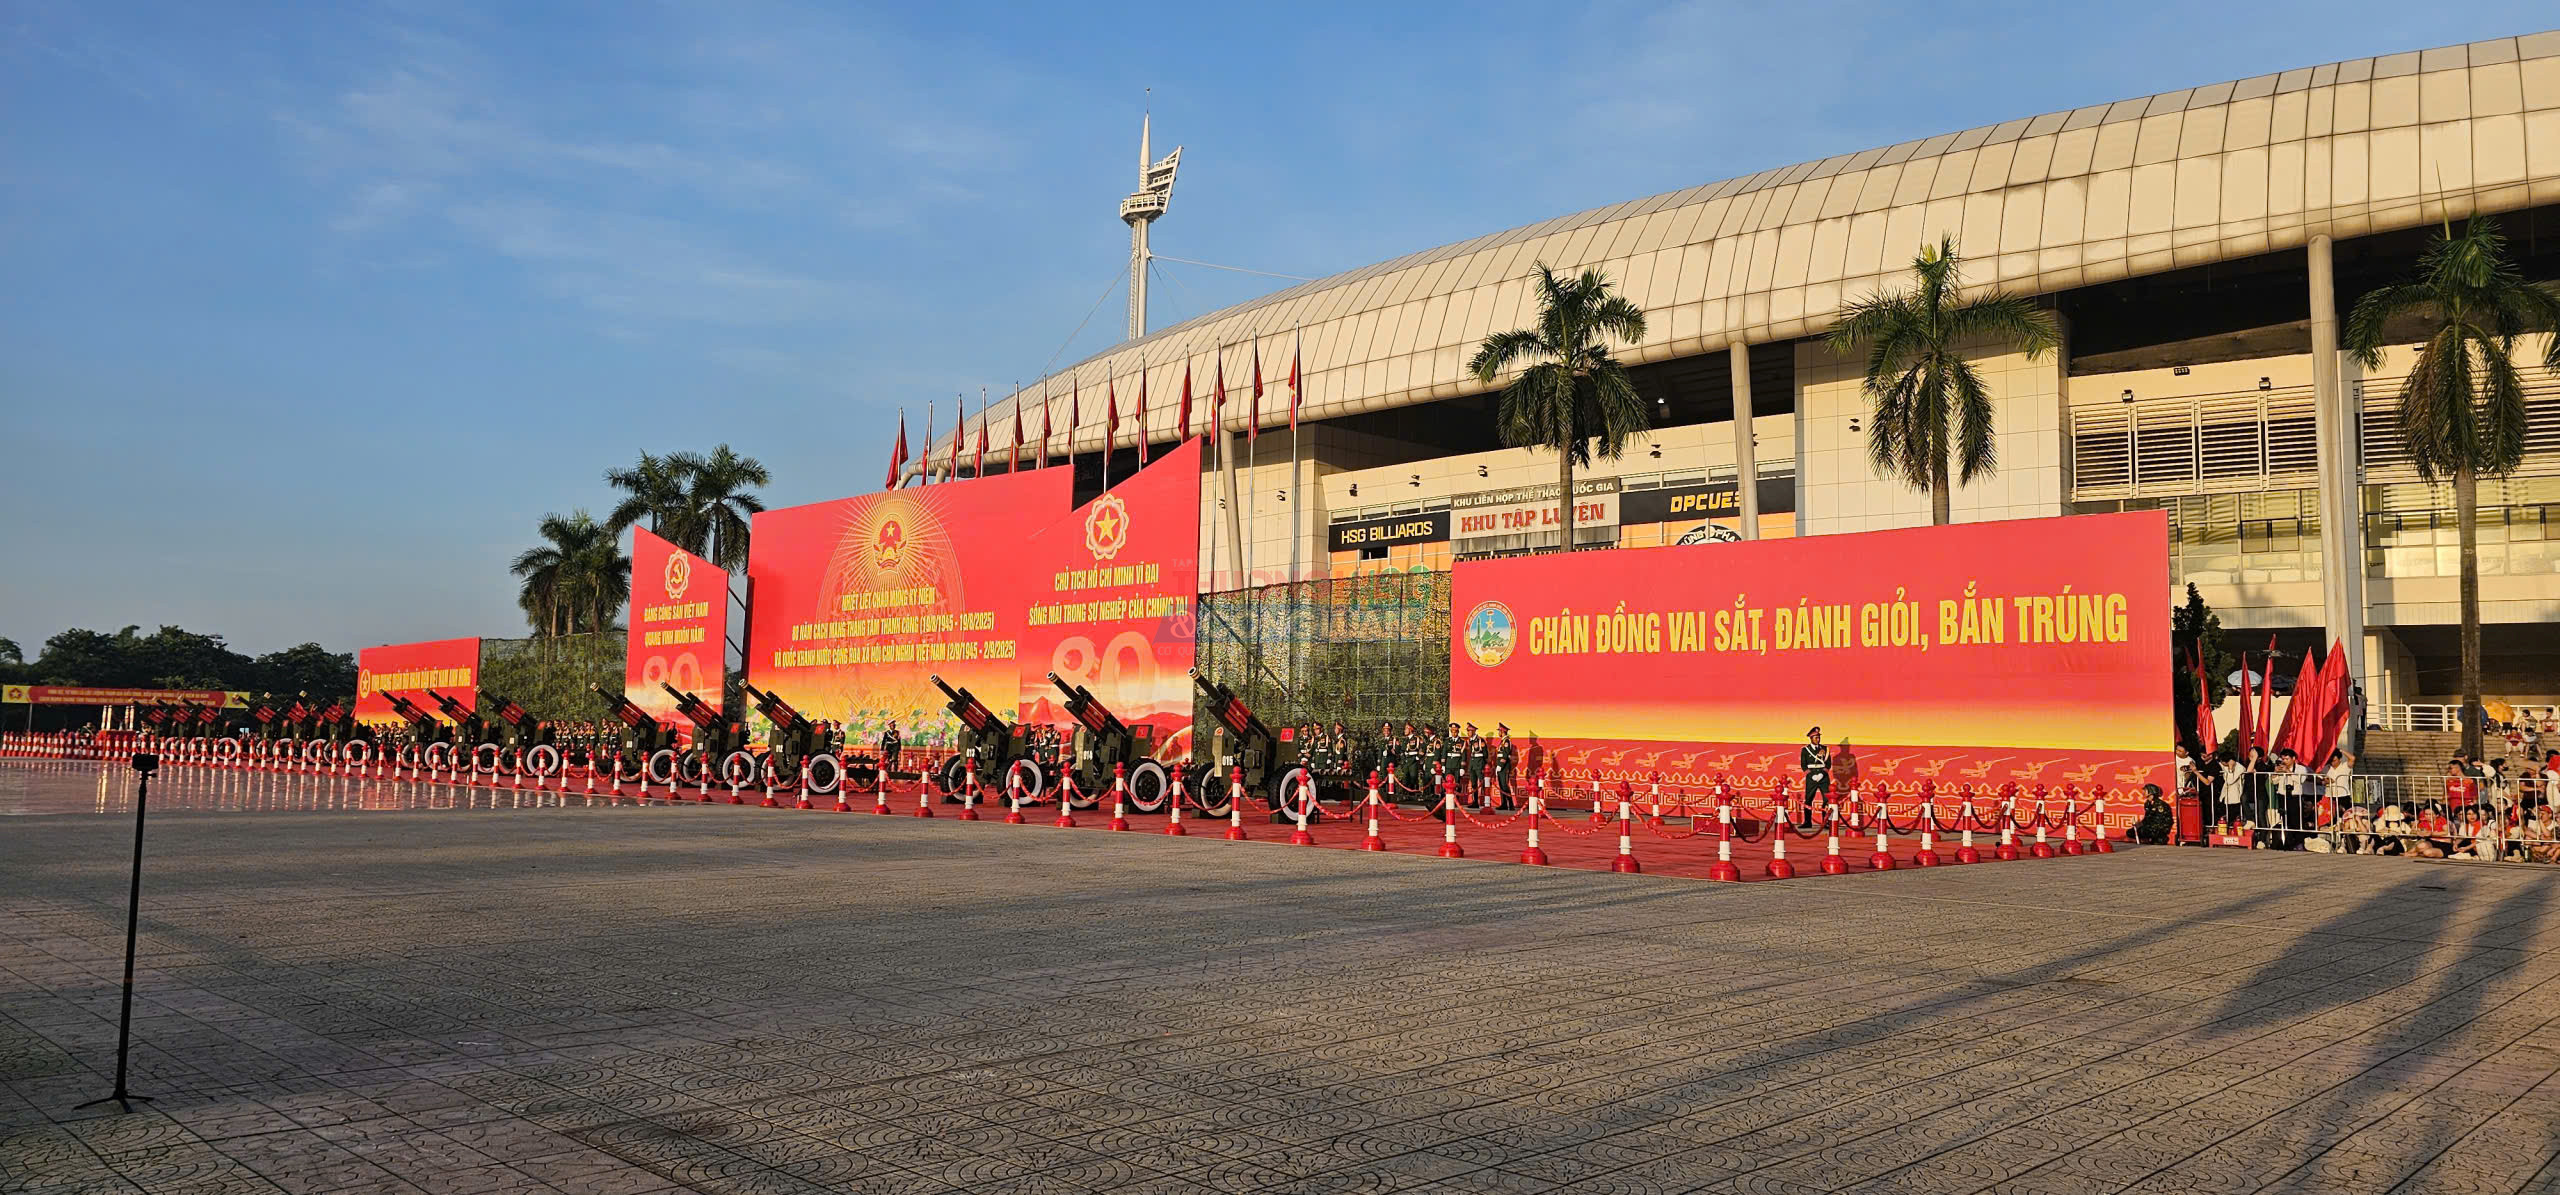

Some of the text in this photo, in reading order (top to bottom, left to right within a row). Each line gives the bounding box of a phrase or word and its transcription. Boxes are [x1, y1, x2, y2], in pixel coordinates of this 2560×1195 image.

[1453, 498, 1472, 508] KHU
[1474, 494, 1494, 505] LIÊN
[1516, 487, 1534, 500] THỂ
[1596, 482, 1614, 492] GIA
[1341, 520, 1433, 545] HSG BILLIARDS
[1460, 512, 1497, 533] KHU
[1501, 508, 1536, 531] TẬP
[1055, 566, 1069, 592] CHỦ
[1070, 570, 1087, 595] TỊCH
[1099, 564, 1112, 587] CHÍ
[1113, 565, 1135, 586] MINH
[1135, 561, 1145, 584] VĨ
[1145, 563, 1159, 589] ĐẠI
[1028, 600, 1047, 626] SỐNG
[1048, 601, 1062, 625] MÃI
[1063, 602, 1087, 624] TRONG
[1087, 599, 1099, 626] SỰ
[1099, 596, 1127, 624] NGHIỆP
[1128, 593, 1144, 619] CỦA
[1146, 593, 1174, 619] CHÚNG
[1529, 607, 1590, 656] CHÂN
[1595, 600, 1661, 655] ĐỒNG
[1667, 611, 1706, 653] VAI
[1713, 593, 1768, 656] SẮT,
[1774, 597, 1851, 650] ĐÁNH
[1860, 586, 1929, 653] GIỎI,
[1939, 581, 2005, 646] BẮN
[2014, 584, 2129, 644] TRÚNG
[983, 640, 1016, 660] 2/9/2025)
[1222, 755, 1234, 766] 015
